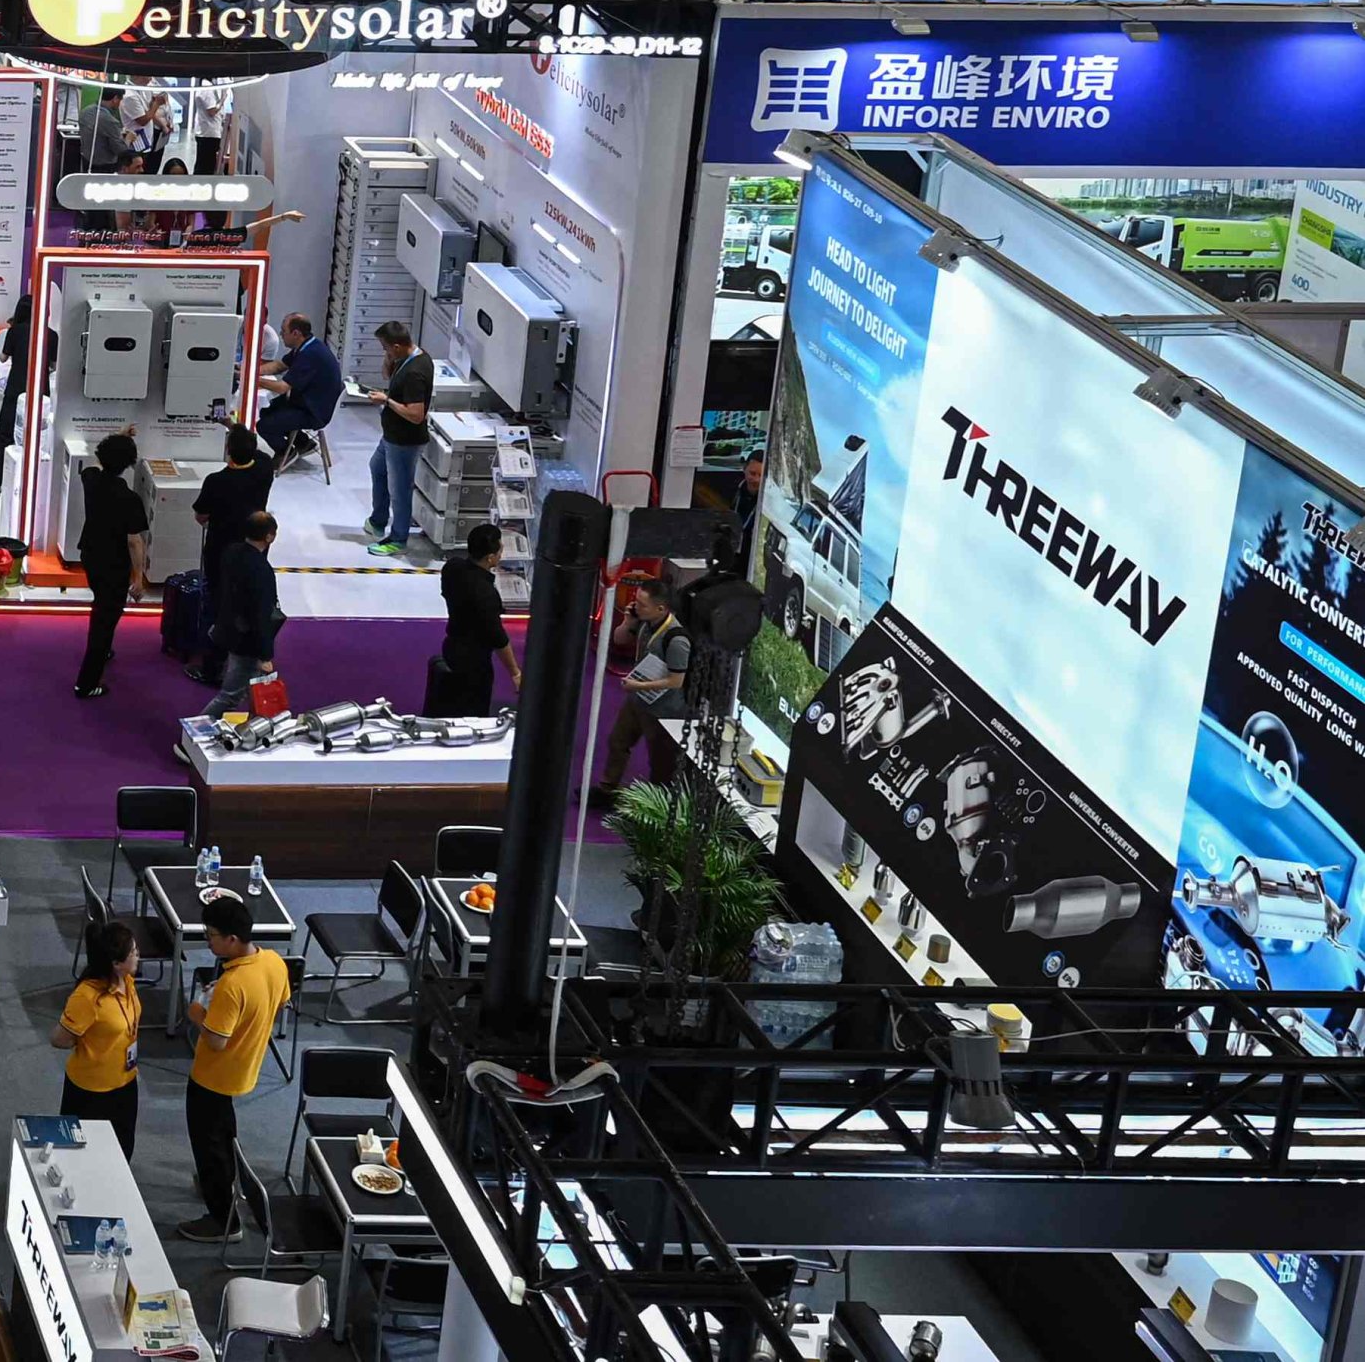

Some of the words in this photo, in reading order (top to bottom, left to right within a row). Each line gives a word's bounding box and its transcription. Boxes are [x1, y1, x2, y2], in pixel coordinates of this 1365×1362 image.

[867, 54, 1119, 101] 盈峰环境
[863, 105, 979, 129] INFORE
[991, 104, 1111, 130] ENVIRO
[826, 236, 853, 274] HEAD
[852, 255, 866, 279] TO
[866, 266, 897, 307] LIGHT
[1292, 273, 1310, 291] 400
[807, 266, 852, 317] JOURNEY
[851, 297, 866, 328] TO
[864, 310, 908, 360] DELIGHT
[941, 406, 1187, 646] THREEWAY
[1242, 545, 1308, 606] CATALYTIC
[907, 640, 936, 668] DIRECT-FIT
[1285, 629, 1304, 652] FOR
[1237, 651, 1283, 693] APPROVED
[1283, 687, 1324, 725] QUALITY
[1325, 718, 1353, 747] LONG
[1287, 669, 1310, 698] FAST
[1310, 687, 1357, 729] DISPATCH
[989, 718, 1022, 750] DIRECT-FIT
[1069, 791, 1102, 831] UNIVERSAL
[1101, 822, 1139, 861] CONVERTER
